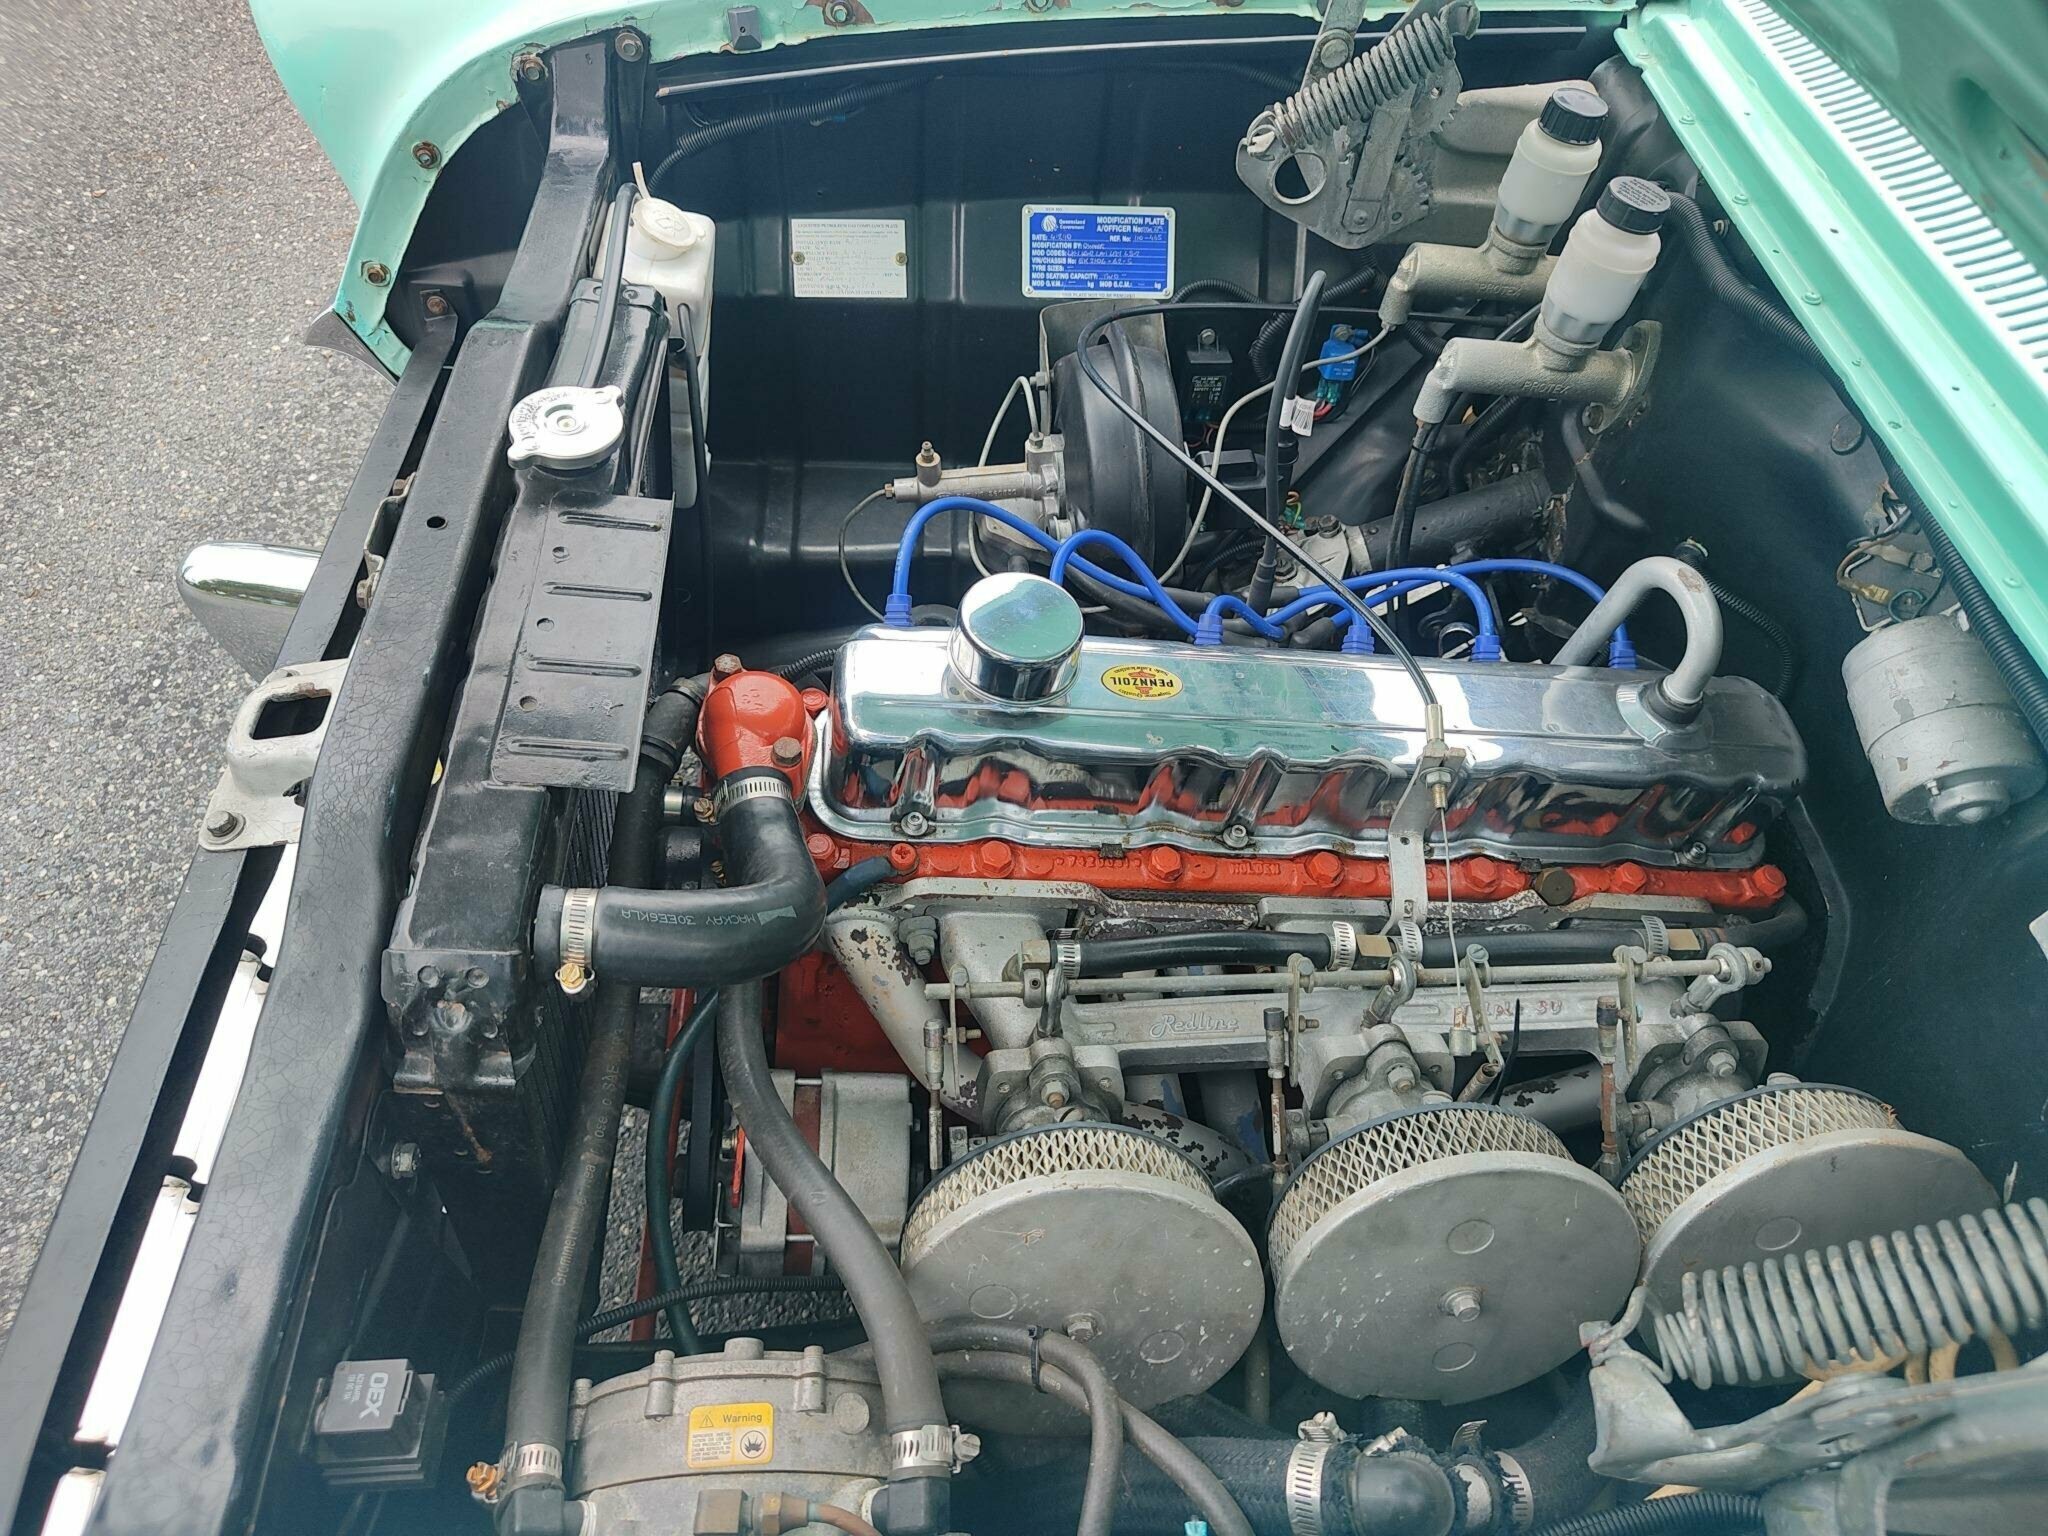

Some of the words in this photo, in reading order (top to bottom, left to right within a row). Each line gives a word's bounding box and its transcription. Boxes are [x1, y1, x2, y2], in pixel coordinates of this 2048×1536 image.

[1096, 216, 1143, 225] MODIFICATION
[1144, 217, 1165, 226] PLATE
[1096, 225, 1132, 233] A/OFFICER
[1031, 249, 1045, 257] MOD
[1046, 272, 1069, 280] SEATING
[1109, 676, 1174, 688] PENNZOIL
[705, 912, 757, 926] MACKAY
[1150, 1012, 1240, 1038] Redline
[358, 1371, 390, 1420] OEX
[723, 1414, 763, 1424] Warning
